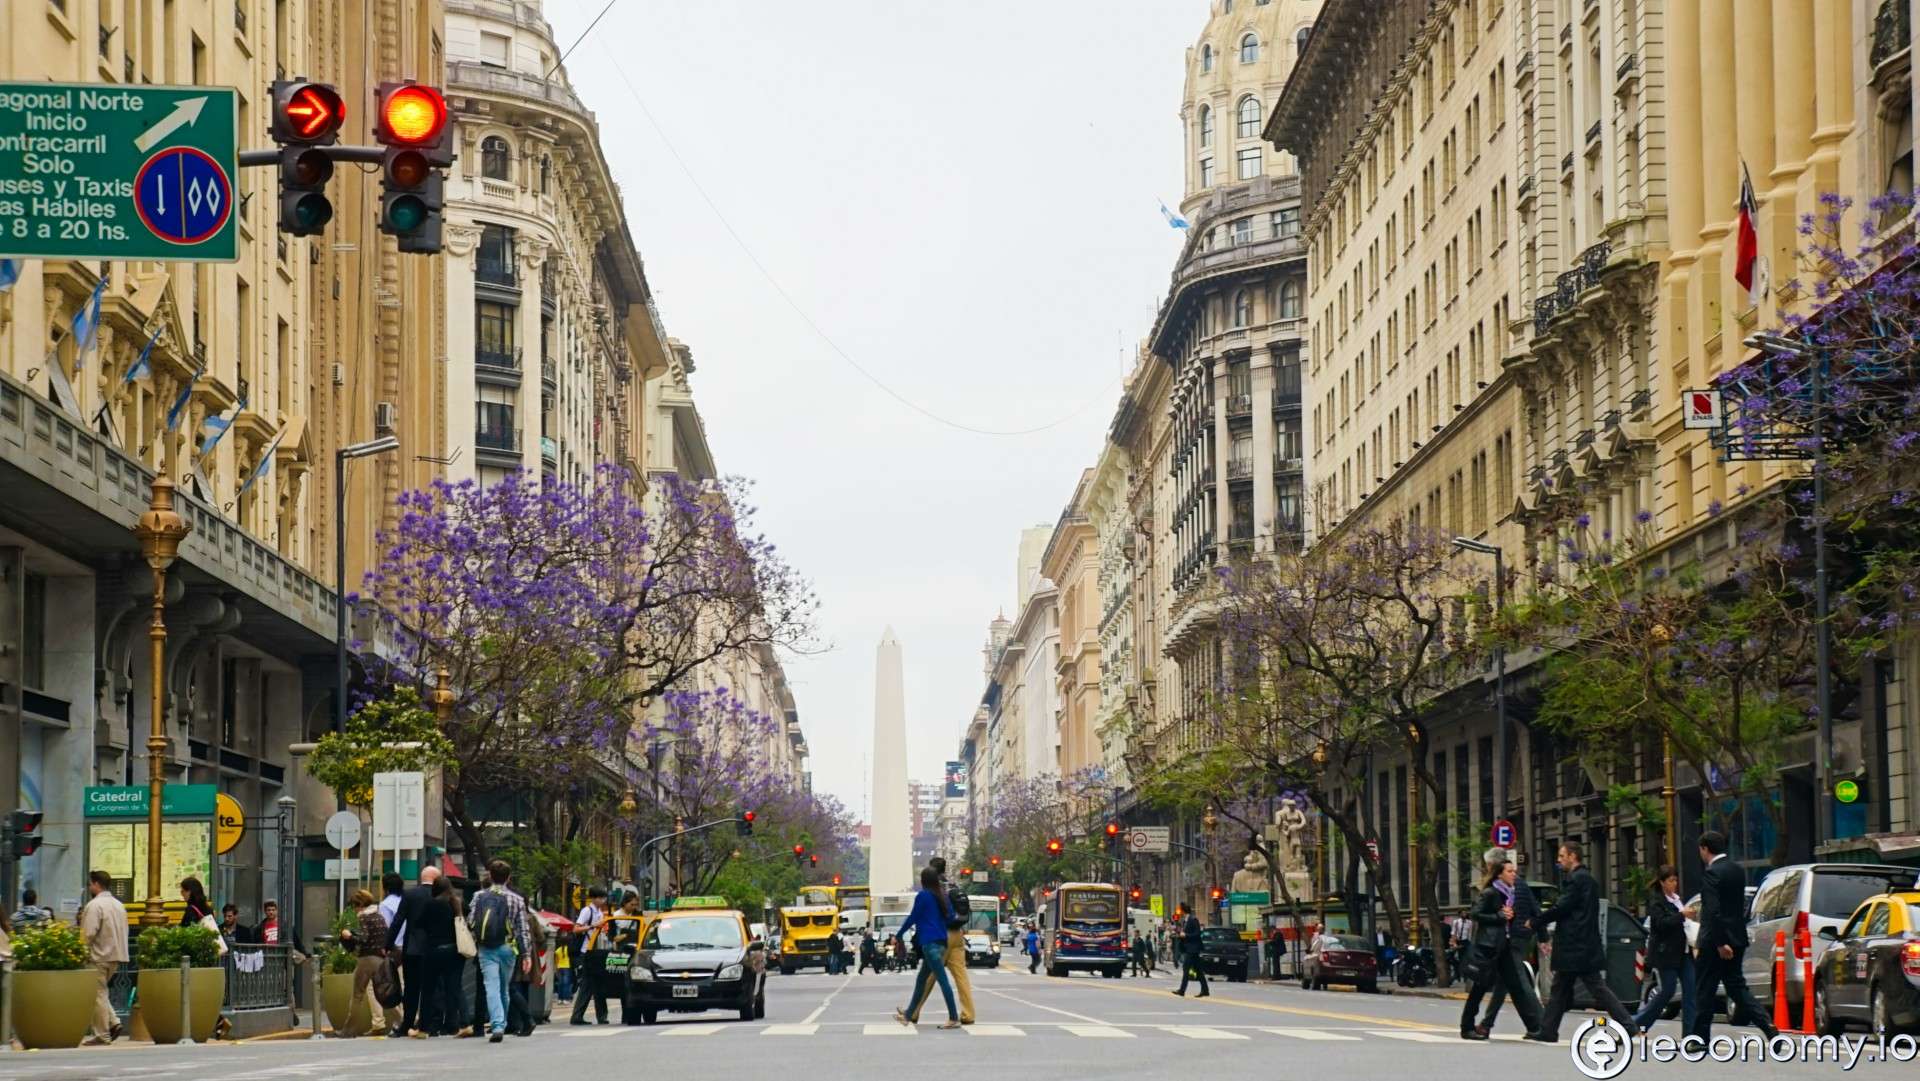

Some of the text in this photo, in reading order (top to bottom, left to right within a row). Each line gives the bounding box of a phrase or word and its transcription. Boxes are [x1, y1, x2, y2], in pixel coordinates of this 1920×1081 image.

[80, 91, 144, 111] Norte
[27, 111, 87, 131] Inicio
[24, 153, 75, 174] Solo
[53, 181, 66, 199] y
[74, 177, 134, 197] Taxis
[12, 218, 28, 238] 8
[37, 223, 51, 238] a
[60, 220, 90, 239] 20
[98, 221, 130, 240] hs.
[90, 790, 143, 803] Catedral
[1498, 825, 1510, 846] E
